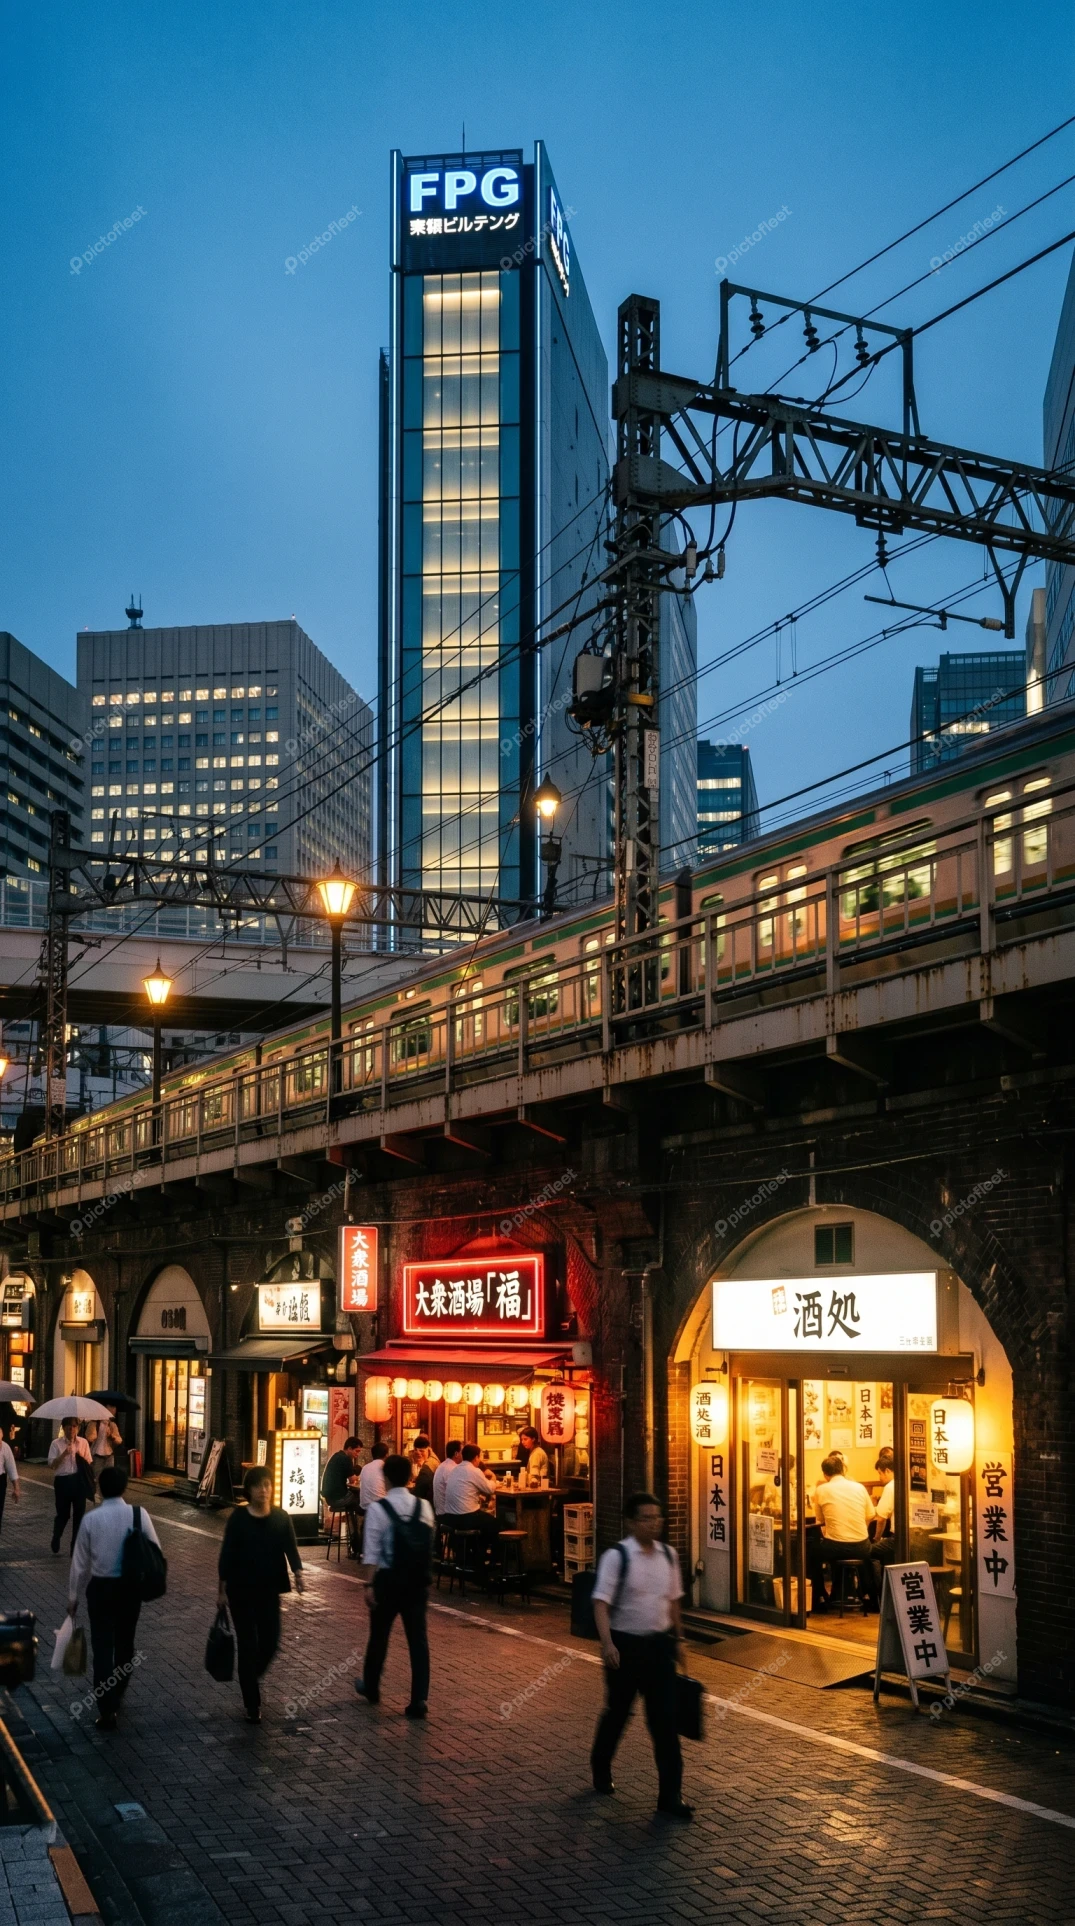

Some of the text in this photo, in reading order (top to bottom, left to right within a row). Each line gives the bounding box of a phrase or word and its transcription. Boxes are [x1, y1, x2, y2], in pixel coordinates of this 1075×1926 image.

[410, 167, 520, 212] FPG
[350, 1230, 370, 1308] 大衆酒場
[414, 1270, 532, 1321] 大衆酒場「福」
[793, 1290, 861, 1339] 酒処
[859, 1388, 873, 1440] 日本酒
[933, 1408, 950, 1465] 日本酒
[709, 1454, 727, 1543] 日本酒
[981, 1461, 1010, 1588] 営業中
[901, 1571, 939, 1668] 営業中
